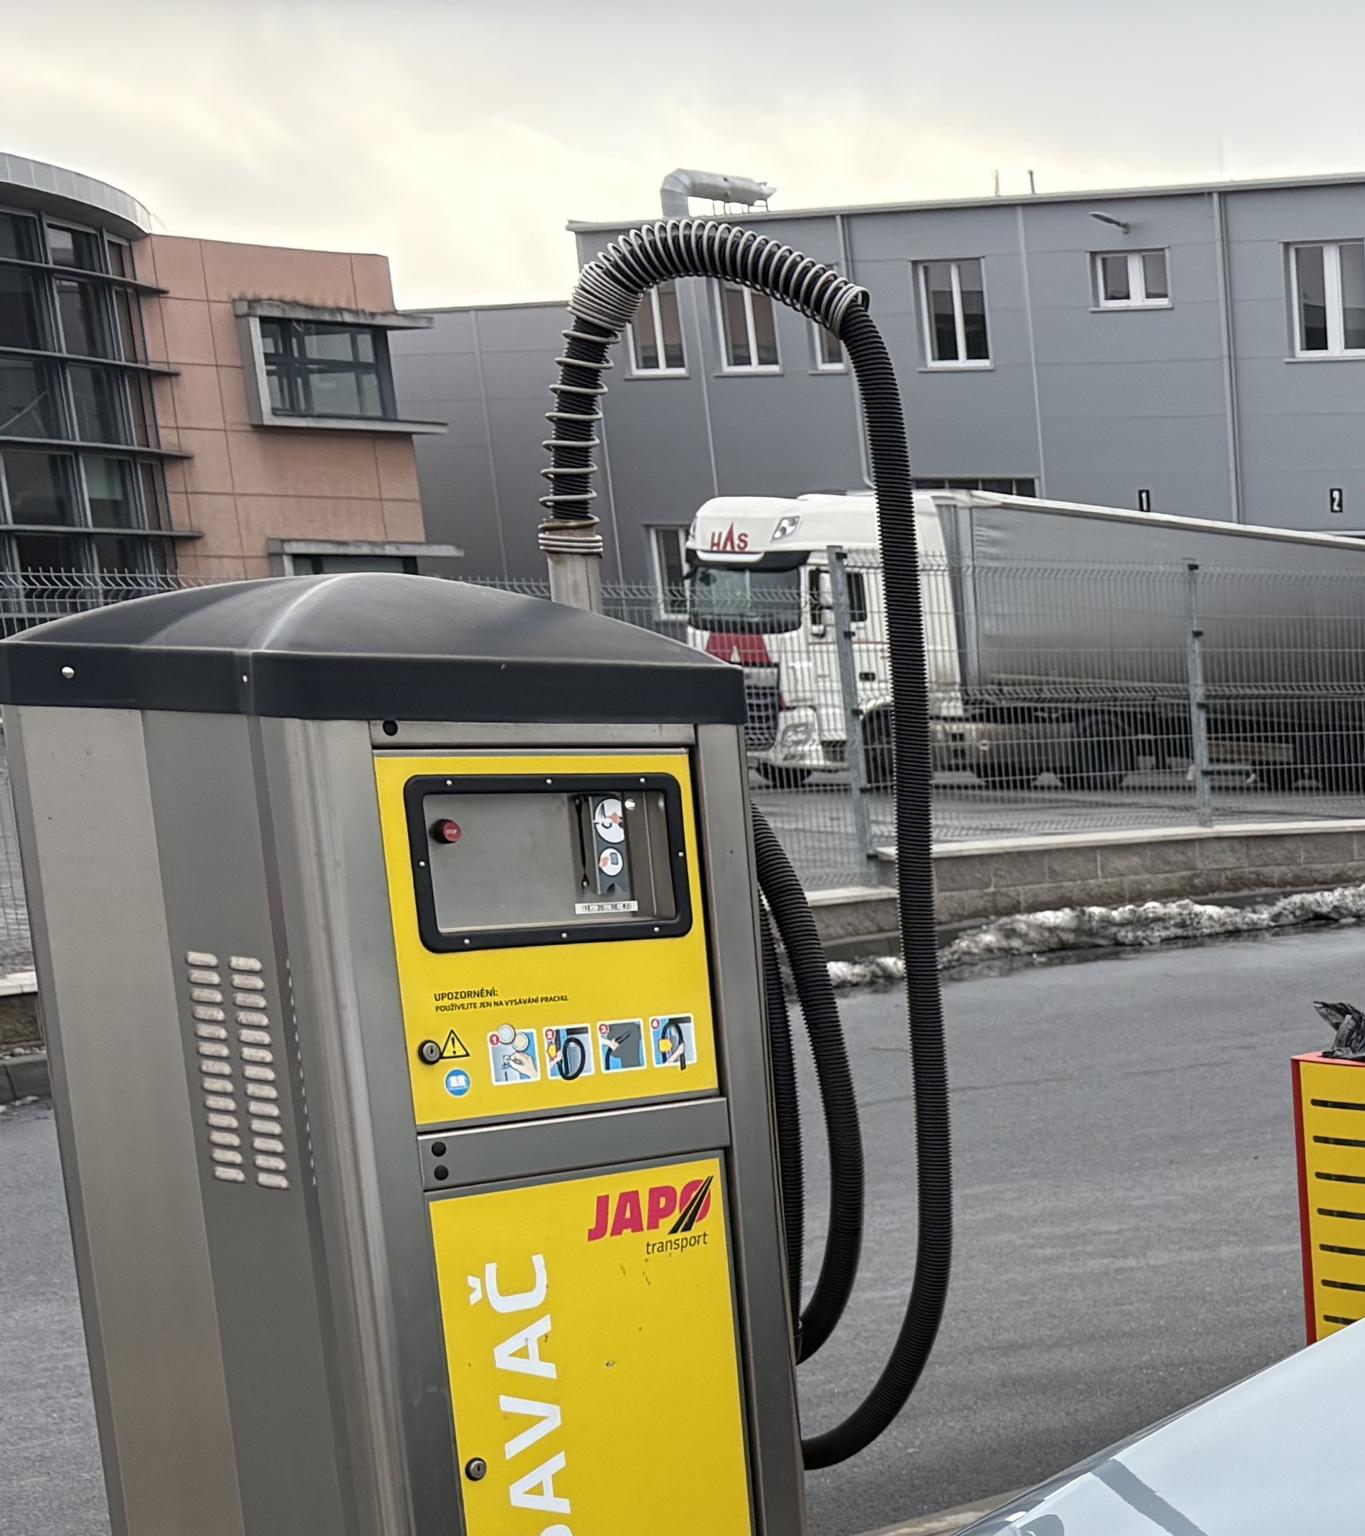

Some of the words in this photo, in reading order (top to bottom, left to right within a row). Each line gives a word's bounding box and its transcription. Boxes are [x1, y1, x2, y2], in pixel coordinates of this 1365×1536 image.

[1332, 490, 1341, 511] 2
[711, 521, 749, 551] HAS
[493, 999, 504, 1007] NA
[587, 1176, 713, 1241] JAPO
[646, 1232, 709, 1255] transport
